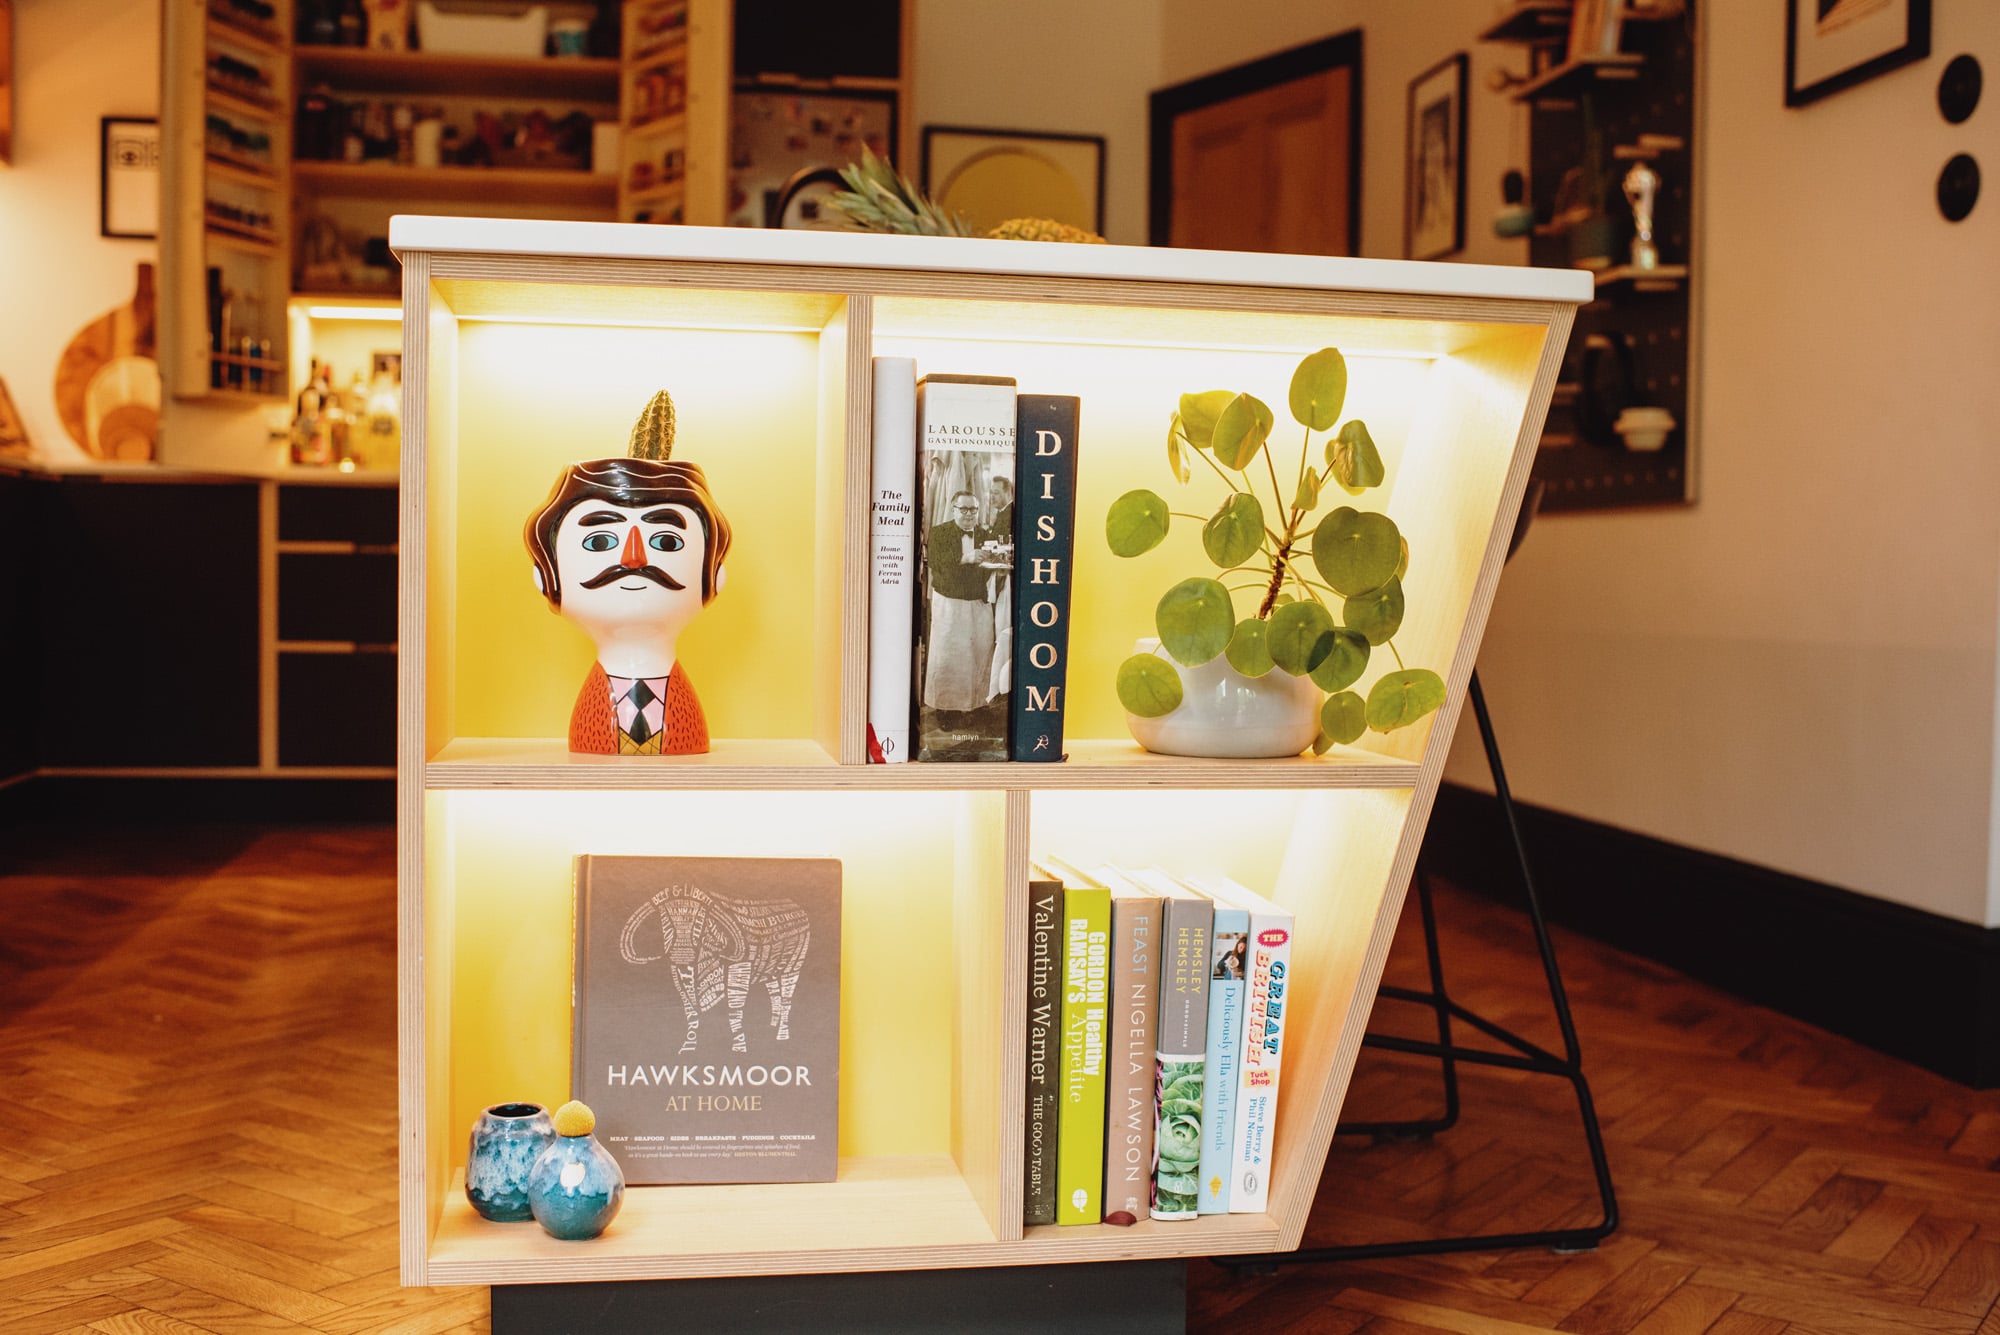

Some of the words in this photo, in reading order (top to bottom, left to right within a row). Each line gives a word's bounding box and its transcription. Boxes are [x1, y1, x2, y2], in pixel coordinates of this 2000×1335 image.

[928, 425, 1016, 437] LAROUSSE
[872, 502, 911, 514] Family
[881, 489, 902, 500] The
[877, 516, 905, 526] Meal
[1024, 430, 1063, 711] DISHOOM
[952, 734, 980, 742] hamlyn
[1033, 895, 1055, 999] Valentine
[1132, 916, 1149, 975] FEAST
[1262, 933, 1284, 943] THE
[1068, 918, 1088, 1004] RAMSAY'S
[1087, 931, 1107, 1003] GORDON
[1176, 927, 1189, 993] HEMSLEY
[1191, 927, 1204, 994] HEMSLEY
[1218, 987, 1236, 1049] Deliciously
[1247, 949, 1272, 1067] BRITISH
[1263, 960, 1286, 1055] GREAT
[1031, 1002, 1051, 1085] Warner
[1083, 1008, 1105, 1076] Healthy
[1129, 984, 1147, 1075] NIGELLA
[607, 1065, 812, 1087] HAWKSMOOR
[1066, 1013, 1087, 1103] Appetite
[1219, 1055, 1232, 1076] Ella
[1217, 1080, 1229, 1105] with
[1250, 1078, 1271, 1086] Shop
[665, 1095, 692, 1112] AT
[698, 1095, 763, 1112] HOME
[1033, 1095, 1043, 1120] THE
[1258, 1096, 1267, 1122] Steve
[1125, 1087, 1143, 1182] LAWSON
[1215, 1108, 1228, 1152] Friends
[1244, 1121, 1256, 1162] Norman
[1253, 1125, 1265, 1154] Berry
[1253, 1155, 1262, 1165] &
